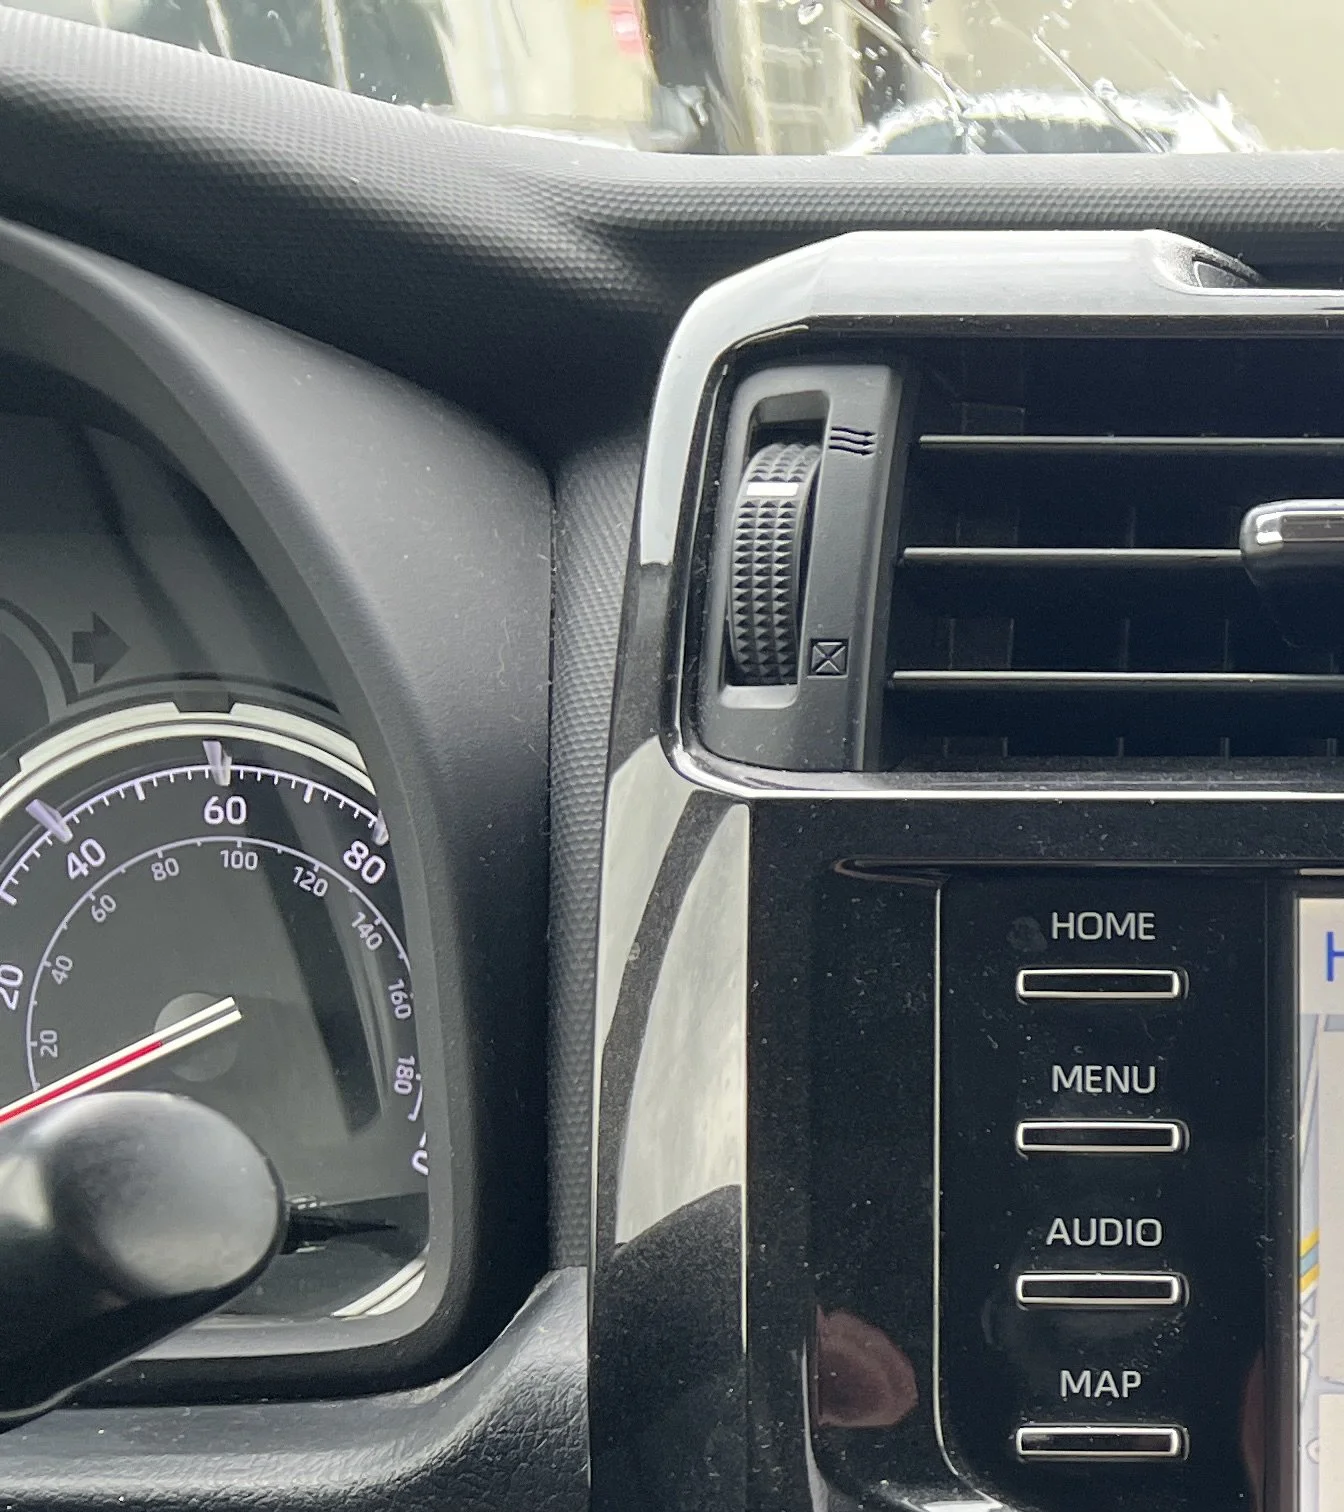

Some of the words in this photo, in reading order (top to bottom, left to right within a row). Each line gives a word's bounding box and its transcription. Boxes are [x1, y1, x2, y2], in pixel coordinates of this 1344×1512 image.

[204, 796, 247, 825] 60
[64, 839, 107, 880] 40
[151, 857, 180, 883] 80
[220, 849, 258, 871] 100
[343, 840, 387, 884] 80
[291, 866, 329, 898] 120
[89, 894, 118, 924] 60
[350, 911, 384, 952] 140
[1051, 911, 1156, 941] HOME
[51, 955, 73, 985] 40
[388, 979, 412, 1021] 160
[40, 1029, 58, 1058] 20
[394, 1055, 416, 1096] 180
[1051, 1065, 1156, 1094] MENU
[1046, 1218, 1163, 1247] AUDIO
[1059, 1370, 1142, 1398] MAP
